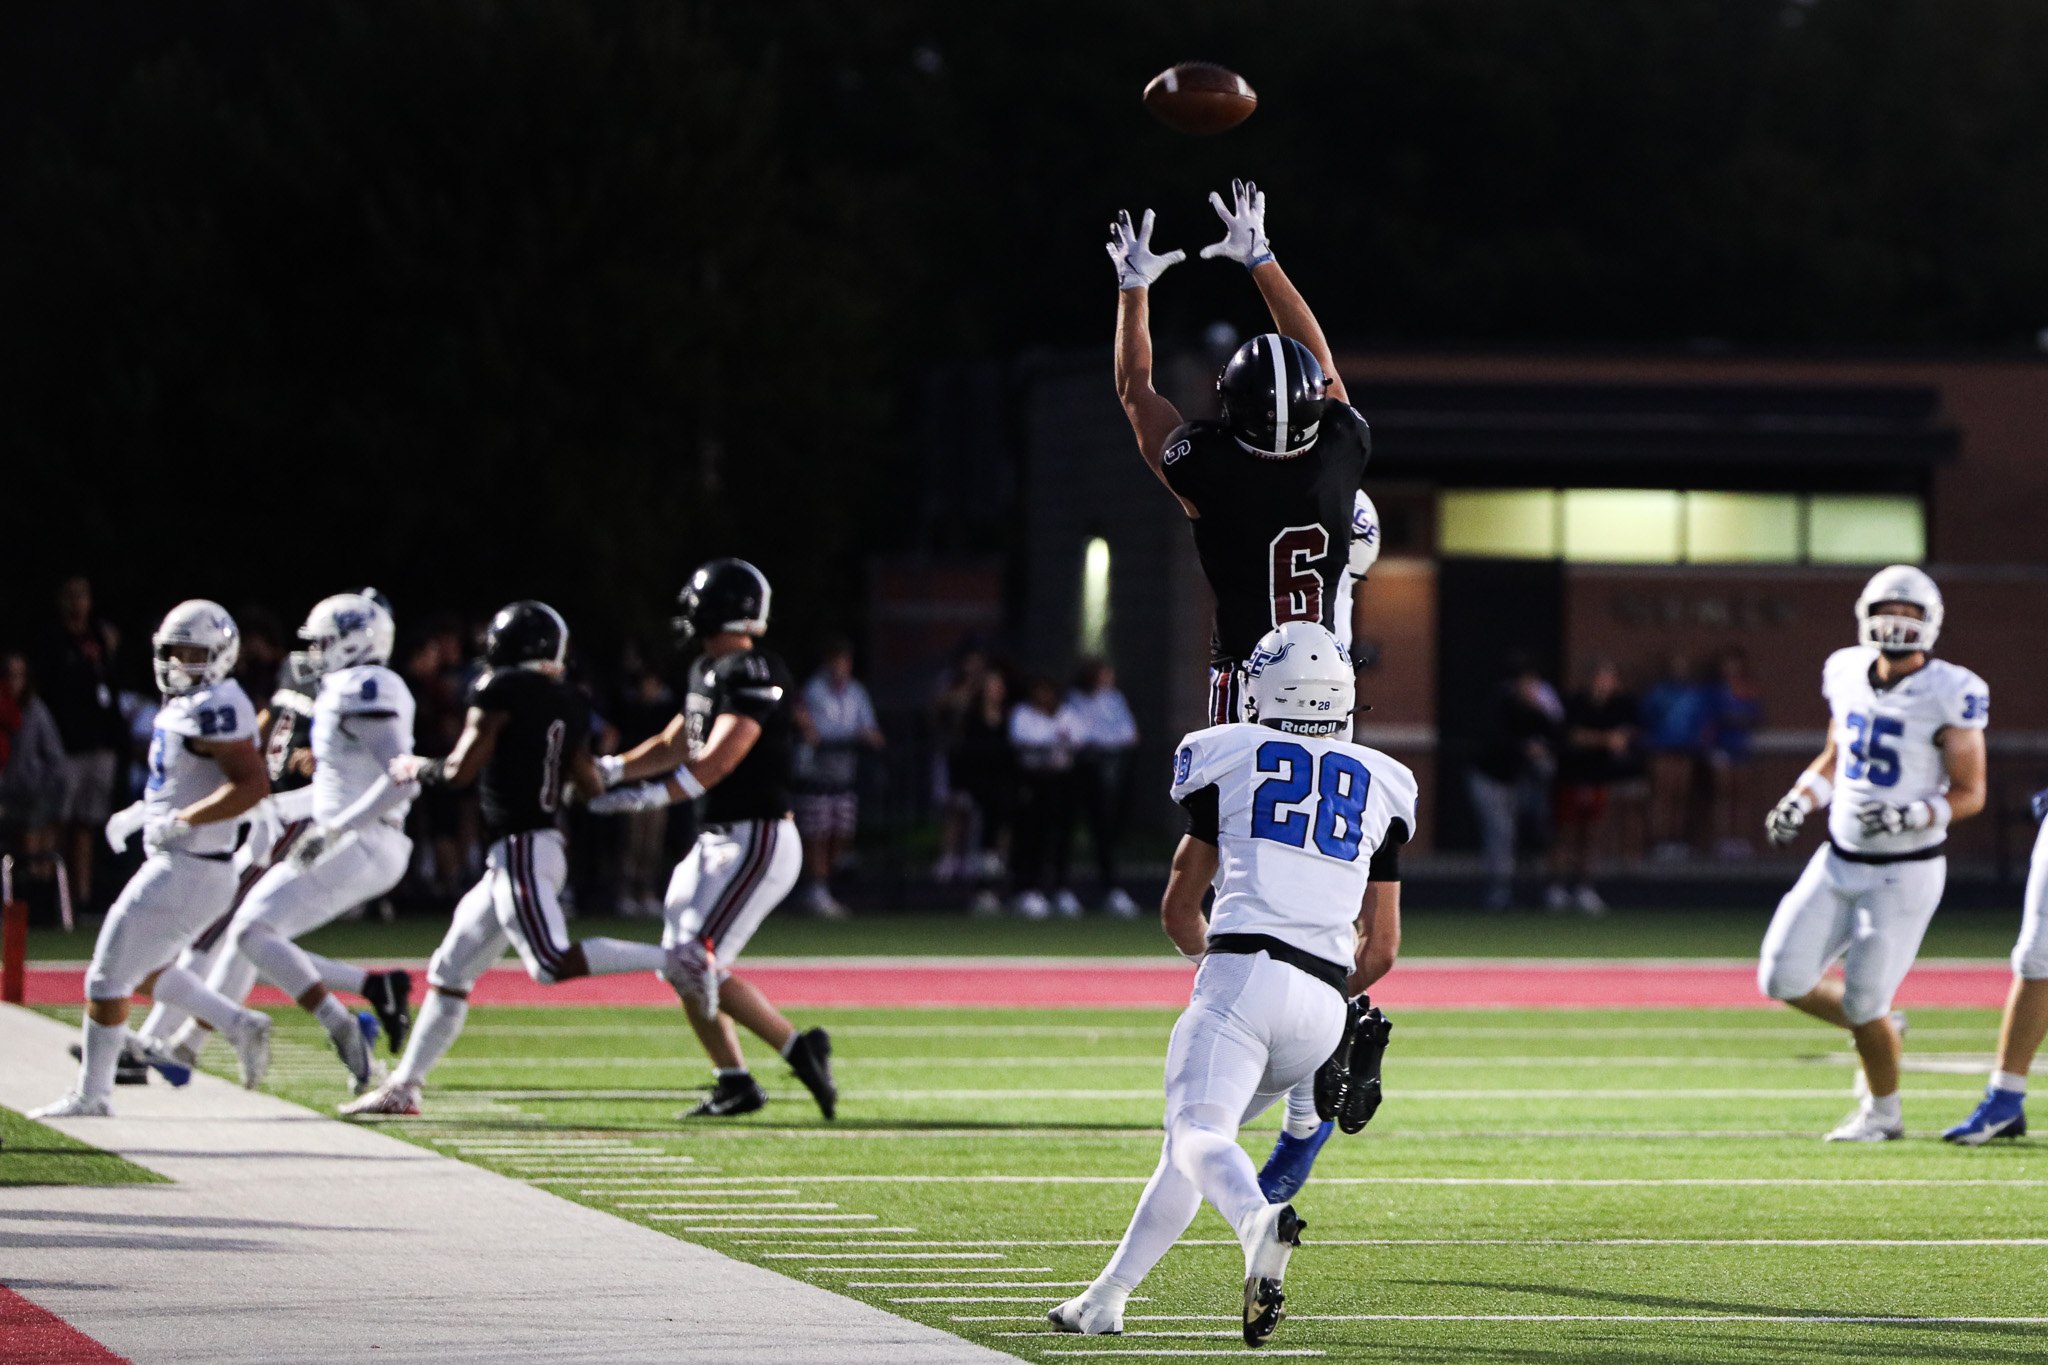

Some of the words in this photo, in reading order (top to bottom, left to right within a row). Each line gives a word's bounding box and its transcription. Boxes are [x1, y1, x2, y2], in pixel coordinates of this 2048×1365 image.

[1269, 523, 1329, 629] 6
[199, 704, 238, 735] 23
[1281, 721, 1337, 735] Riddell
[1317, 701, 1331, 711] 28
[1845, 712, 1904, 787] 35
[1251, 741, 1371, 862] 28
